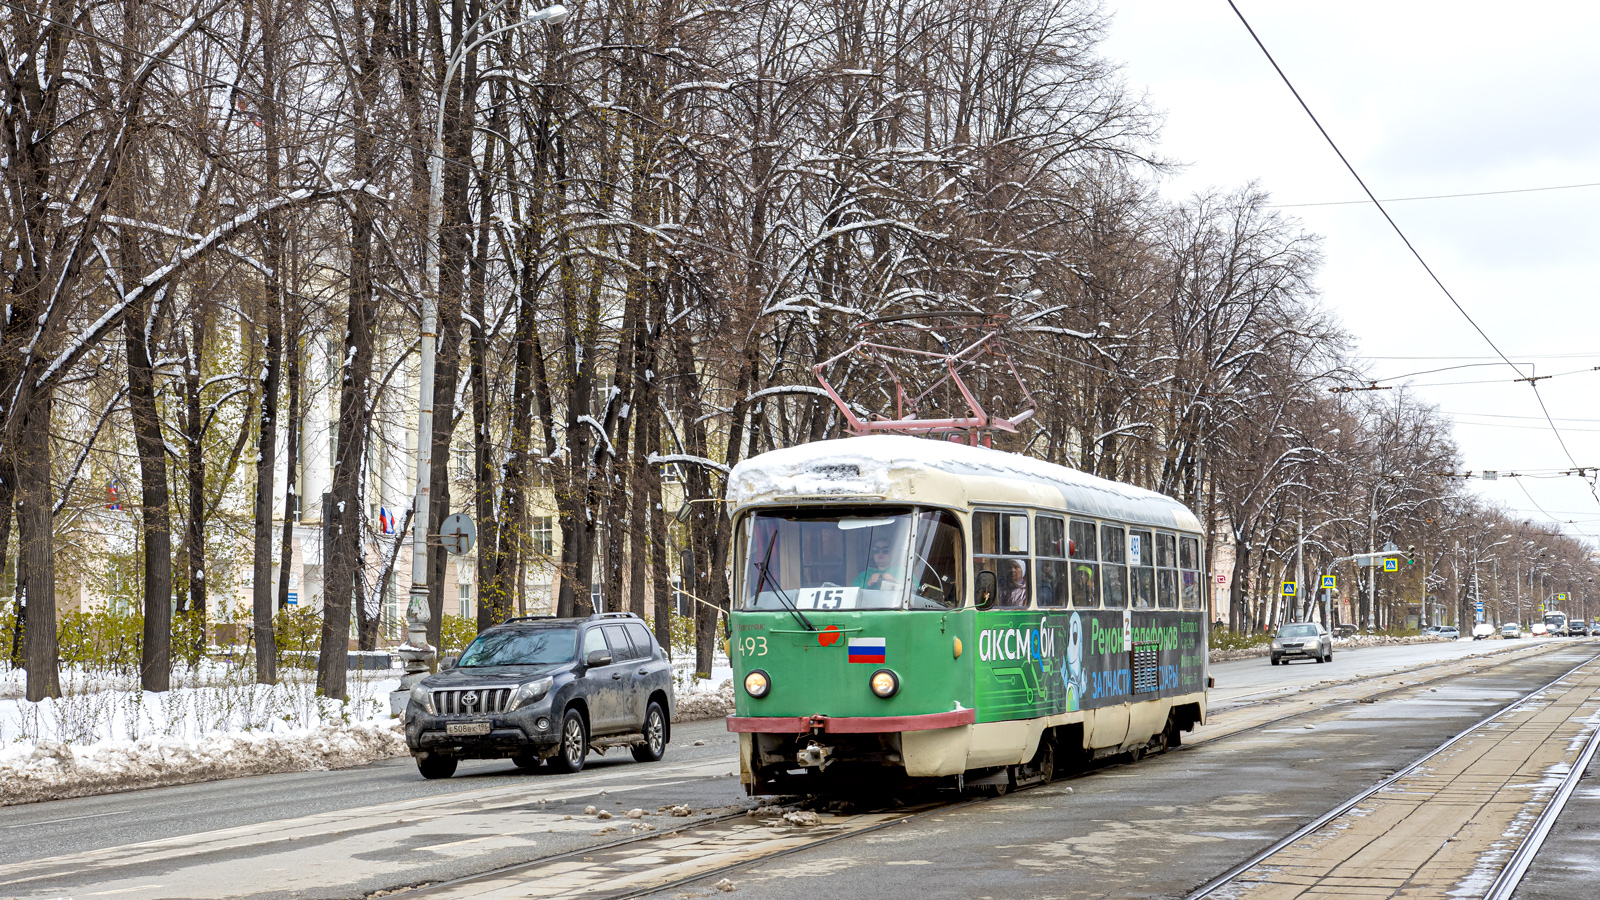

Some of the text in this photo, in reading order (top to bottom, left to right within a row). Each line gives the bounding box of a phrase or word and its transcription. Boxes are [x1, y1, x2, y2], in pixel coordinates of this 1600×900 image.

[811, 590, 849, 609] 15
[738, 636, 768, 656] 493
[1091, 618, 1127, 655] Ремон
[1092, 669, 1131, 699] ЗАПЧАСТИ
